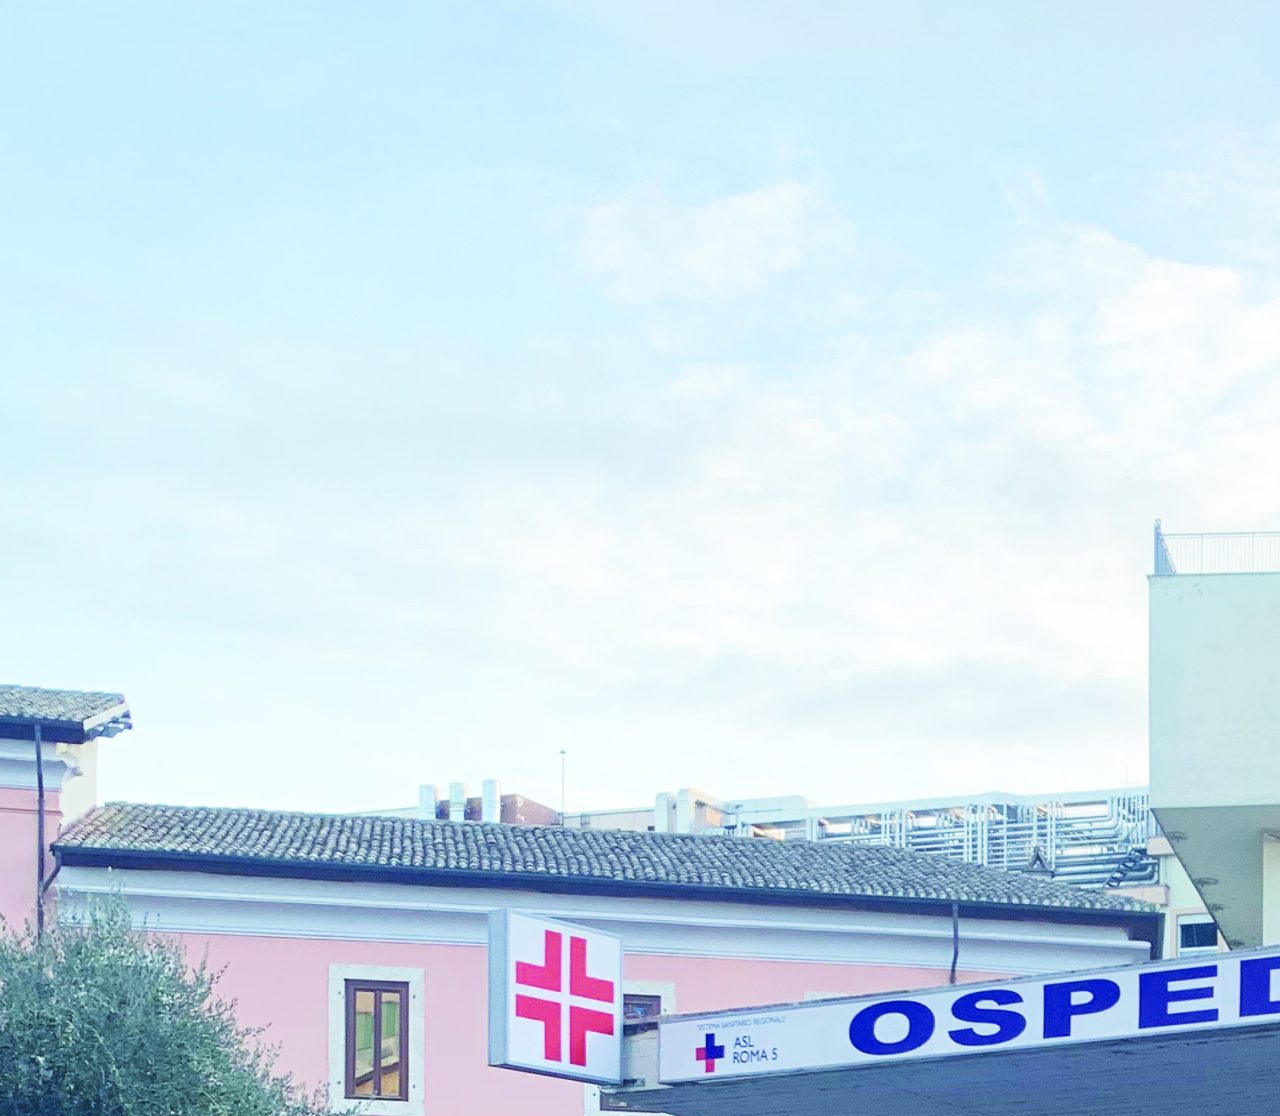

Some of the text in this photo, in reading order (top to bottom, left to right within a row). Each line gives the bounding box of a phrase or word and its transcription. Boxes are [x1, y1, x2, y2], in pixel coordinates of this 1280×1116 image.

[733, 1035, 755, 1048] ASL
[733, 1047, 778, 1064] ROMA 5
